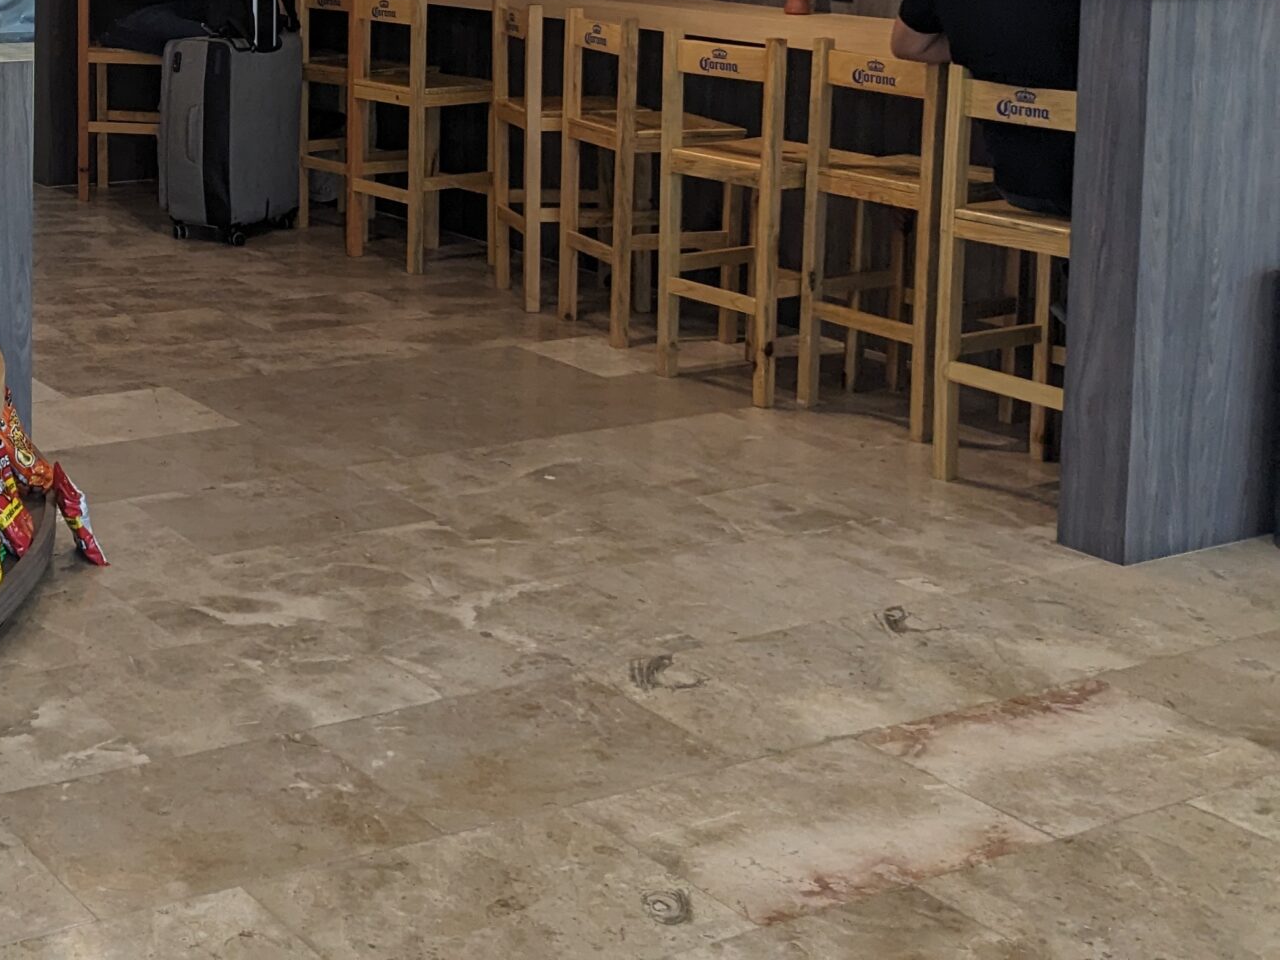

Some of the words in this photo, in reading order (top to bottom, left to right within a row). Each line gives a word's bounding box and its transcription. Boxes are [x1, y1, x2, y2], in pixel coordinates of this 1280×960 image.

[371, 6, 397, 19] Corona
[584, 32, 608, 47] Corona
[699, 57, 740, 74] Corona
[852, 68, 897, 87] Corona
[996, 99, 1050, 121] Corona
